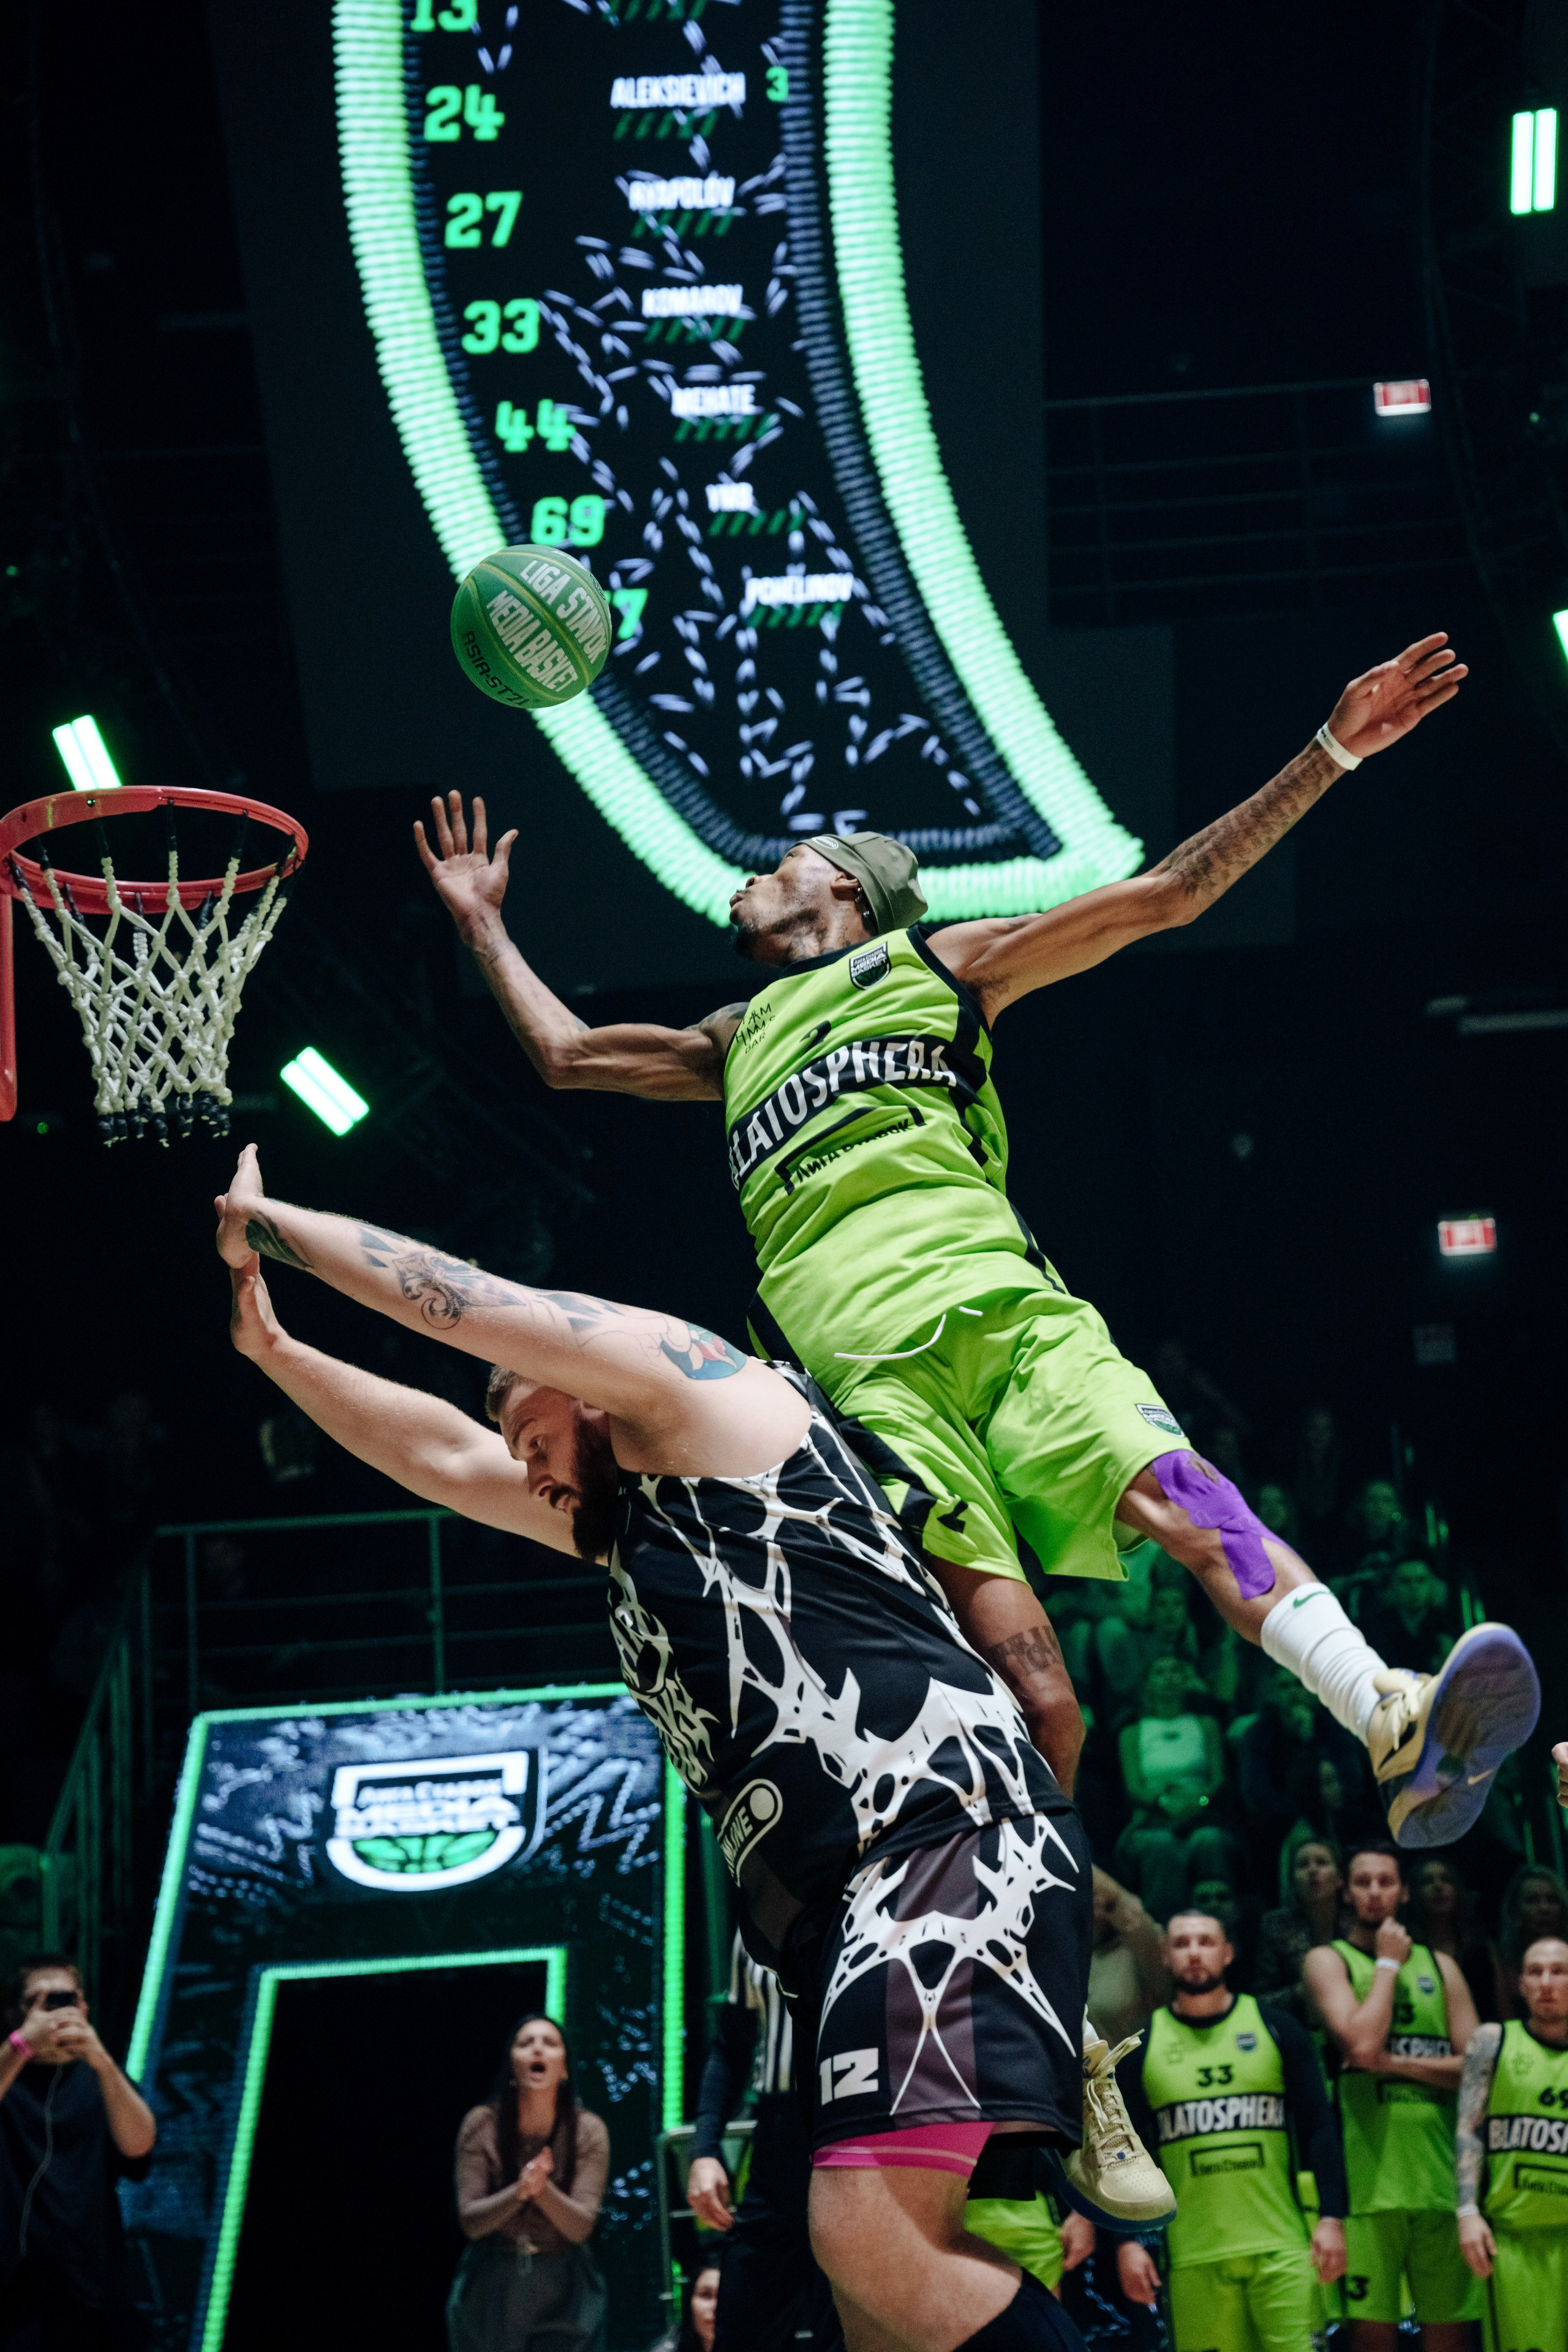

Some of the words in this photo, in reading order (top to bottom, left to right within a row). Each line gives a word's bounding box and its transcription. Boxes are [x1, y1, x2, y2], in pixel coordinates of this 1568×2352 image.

[423, 85, 505, 141] 24
[766, 67, 788, 102] 3
[445, 191, 522, 247] 27
[461, 298, 540, 353] 33
[495, 399, 576, 452] 44
[530, 494, 605, 548] 69
[486, 589, 541, 654] MEDIA
[520, 560, 571, 605] LIGA
[556, 587, 607, 665] STAVOK
[604, 588, 649, 640] 7
[513, 629, 578, 693] BASKET
[819, 2047, 879, 2106] 12
[1197, 2064, 1234, 2087] 33
